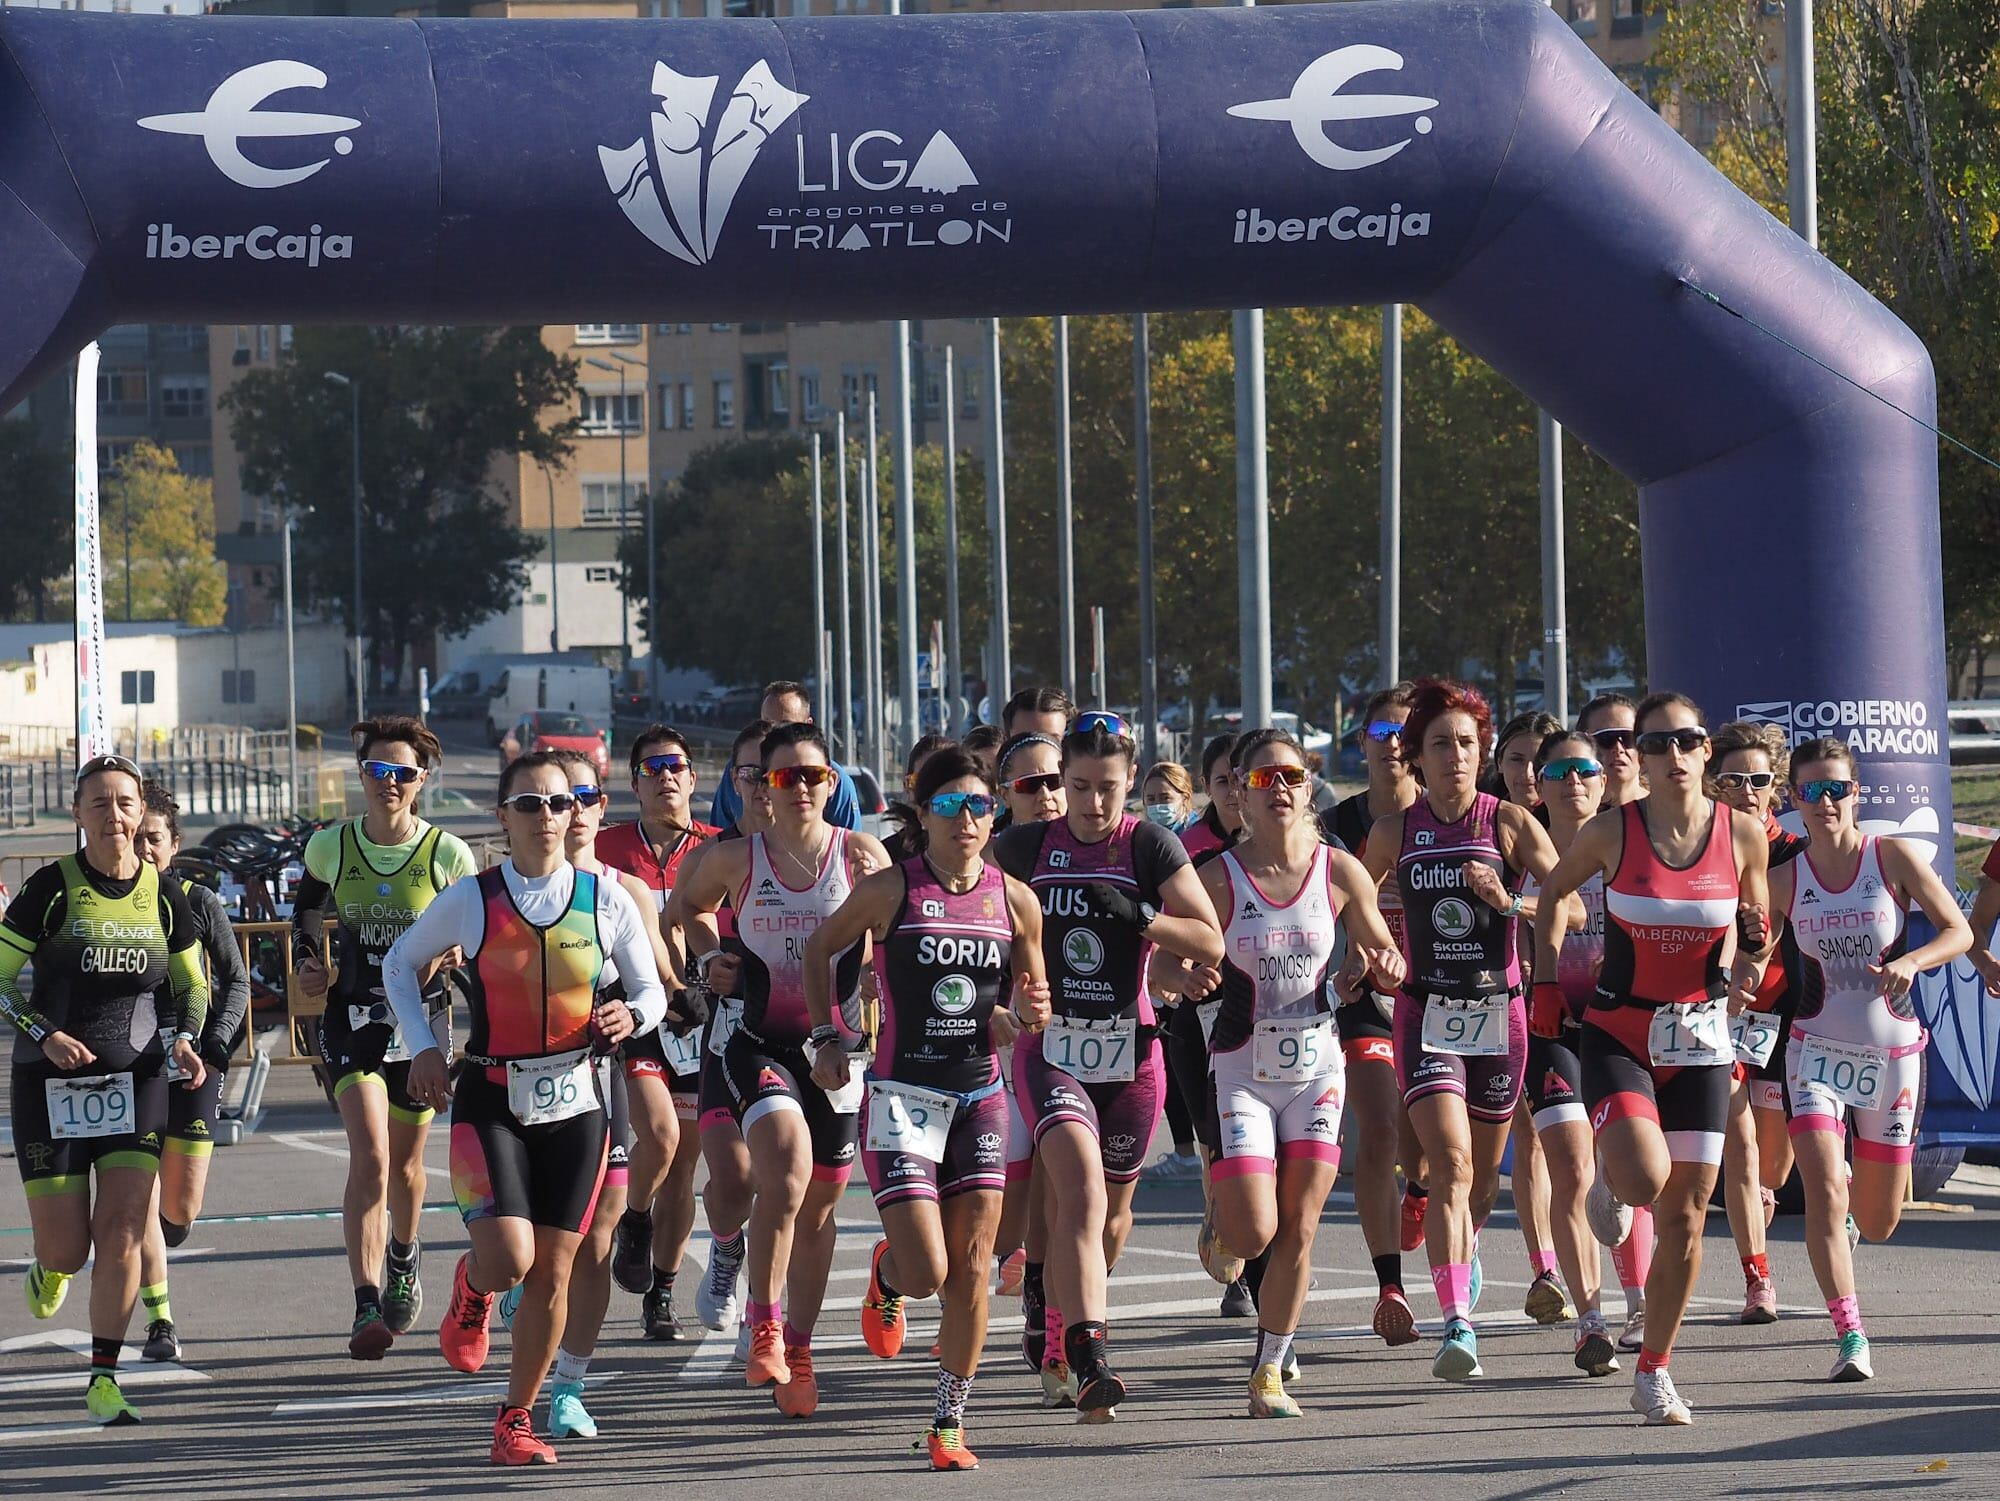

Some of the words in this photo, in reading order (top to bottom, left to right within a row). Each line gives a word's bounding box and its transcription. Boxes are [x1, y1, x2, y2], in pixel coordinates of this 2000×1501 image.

[797, 129, 980, 196] LIGA
[767, 203, 946, 219] aragonesa
[971, 199, 1008, 212] de
[757, 217, 1012, 251] TRIATLON
[1233, 202, 1431, 246] iberCaja
[146, 223, 354, 267] iberCaja
[1793, 700, 1928, 727] GOBIERNO
[1847, 729, 1939, 756] ARAGON
[344, 902, 365, 919] El
[781, 909, 817, 917] TRIATLON
[1798, 911, 1889, 935] EUROPA
[73, 919, 96, 938] El
[360, 922, 409, 947] ANCARA
[1267, 924, 1303, 933] TRIATLON
[1631, 926, 1713, 943] M.BERNAL
[785, 937, 808, 961] RU
[917, 935, 1002, 969] SORIA
[1237, 931, 1331, 953] EUROPA
[1433, 940, 1483, 952] ŠKODA
[1661, 943, 1684, 954] ESP
[1818, 934, 1873, 960] SANCHO
[81, 946, 148, 975] GALLEGO
[1259, 953, 1312, 981] DONOSO
[1434, 952, 1485, 961] ZARATECNO
[1062, 976, 1113, 992] ŠKODA
[1063, 990, 1115, 1002] ZARATECNO
[925, 1016, 977, 1027] ŠKODA
[1444, 1011, 1489, 1042] 97
[671, 1034, 701, 1063] 11
[1057, 1034, 1127, 1070] 107
[1278, 1035, 1318, 1069] 95
[1732, 1025, 1769, 1055] 12
[1413, 1066, 1454, 1078] CINTASA
[1811, 1056, 1879, 1096] 106
[534, 1071, 577, 1109] 96
[61, 1091, 127, 1125] 109
